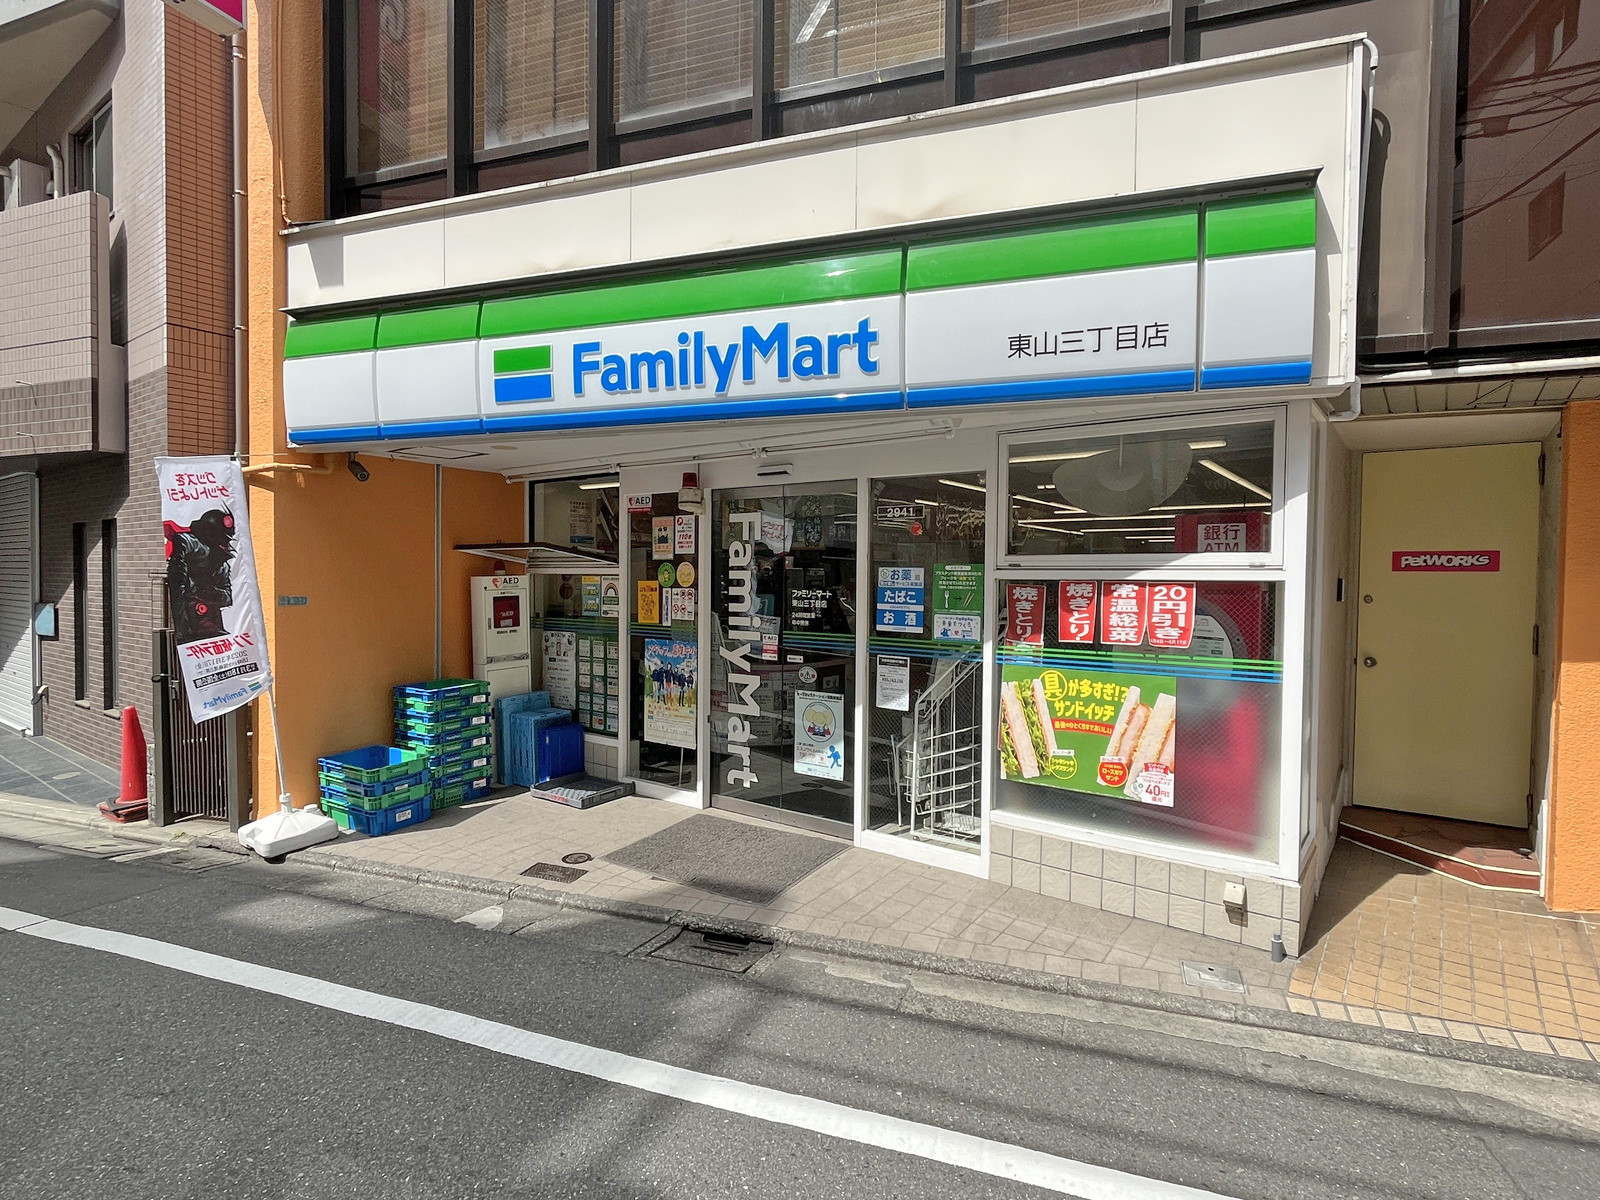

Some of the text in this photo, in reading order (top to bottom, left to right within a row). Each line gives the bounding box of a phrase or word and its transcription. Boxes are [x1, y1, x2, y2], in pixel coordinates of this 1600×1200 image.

[1007, 322, 1169, 358] 東山三丁目店
[573, 318, 879, 397] FamilyMart
[635, 496, 651, 505] AED
[887, 508, 914, 517] 2941
[1203, 524, 1240, 540] 銀行
[890, 569, 912, 580] お薬
[792, 590, 832, 598] ファミリーマート
[884, 590, 916, 603] たばこ
[1109, 584, 1139, 642] 常温総菜
[1151, 585, 1187, 639] 20円引き
[720, 512, 761, 789] FamilyMart
[1044, 673, 1129, 702] 具が多すぎ!?
[1054, 700, 1114, 722] サンドイッチ
[1054, 721, 1112, 734] 最後のひとくちまでおいしい
[1102, 768, 1124, 776] ロースカツ
